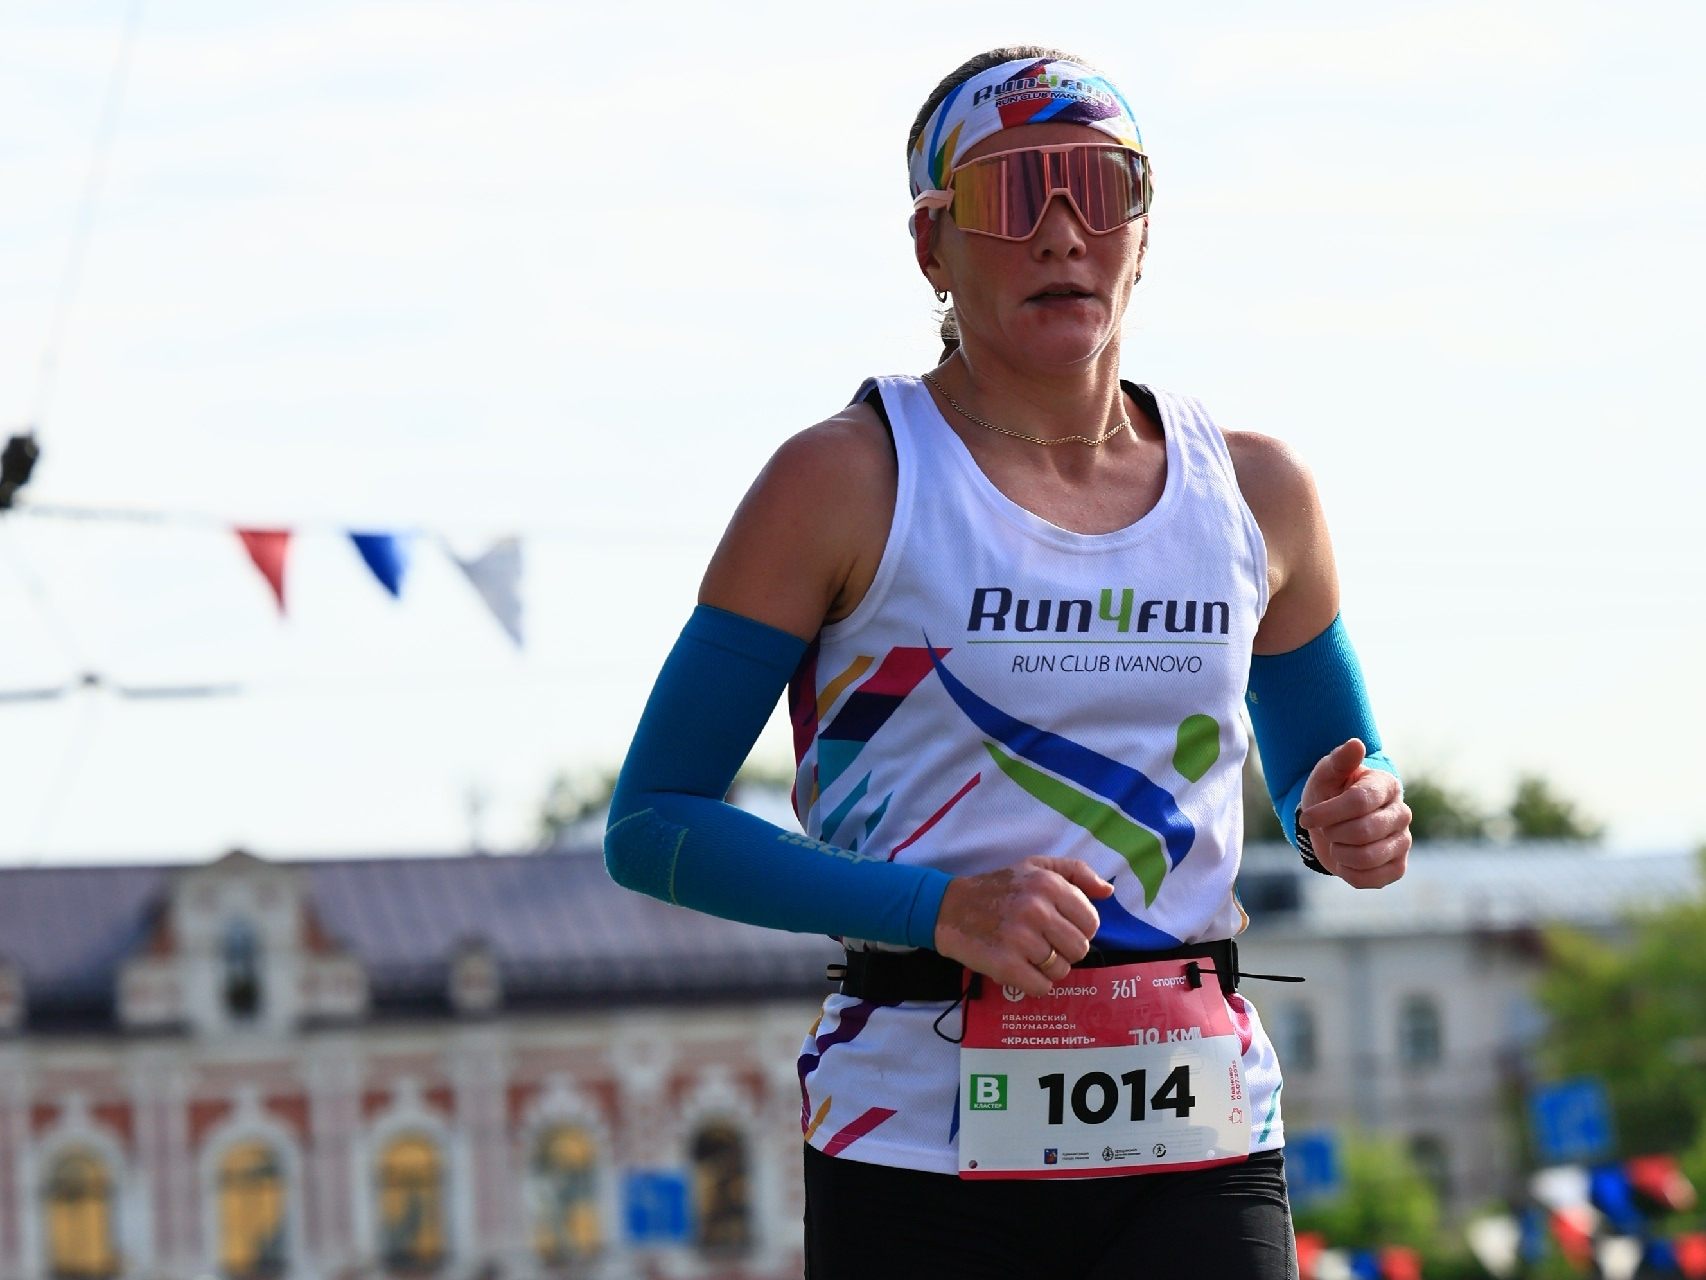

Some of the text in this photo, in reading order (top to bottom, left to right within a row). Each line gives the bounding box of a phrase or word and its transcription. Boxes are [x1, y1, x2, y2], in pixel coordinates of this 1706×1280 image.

[1011, 655, 1203, 673] RUN CLUB IVANOVO
[1038, 986, 1098, 999] армэко
[1001, 1036, 1096, 1045] «КРАСНАЯ НИТЬ»
[1128, 1027, 1160, 1046] 10
[1038, 1065, 1196, 1124] 1014
